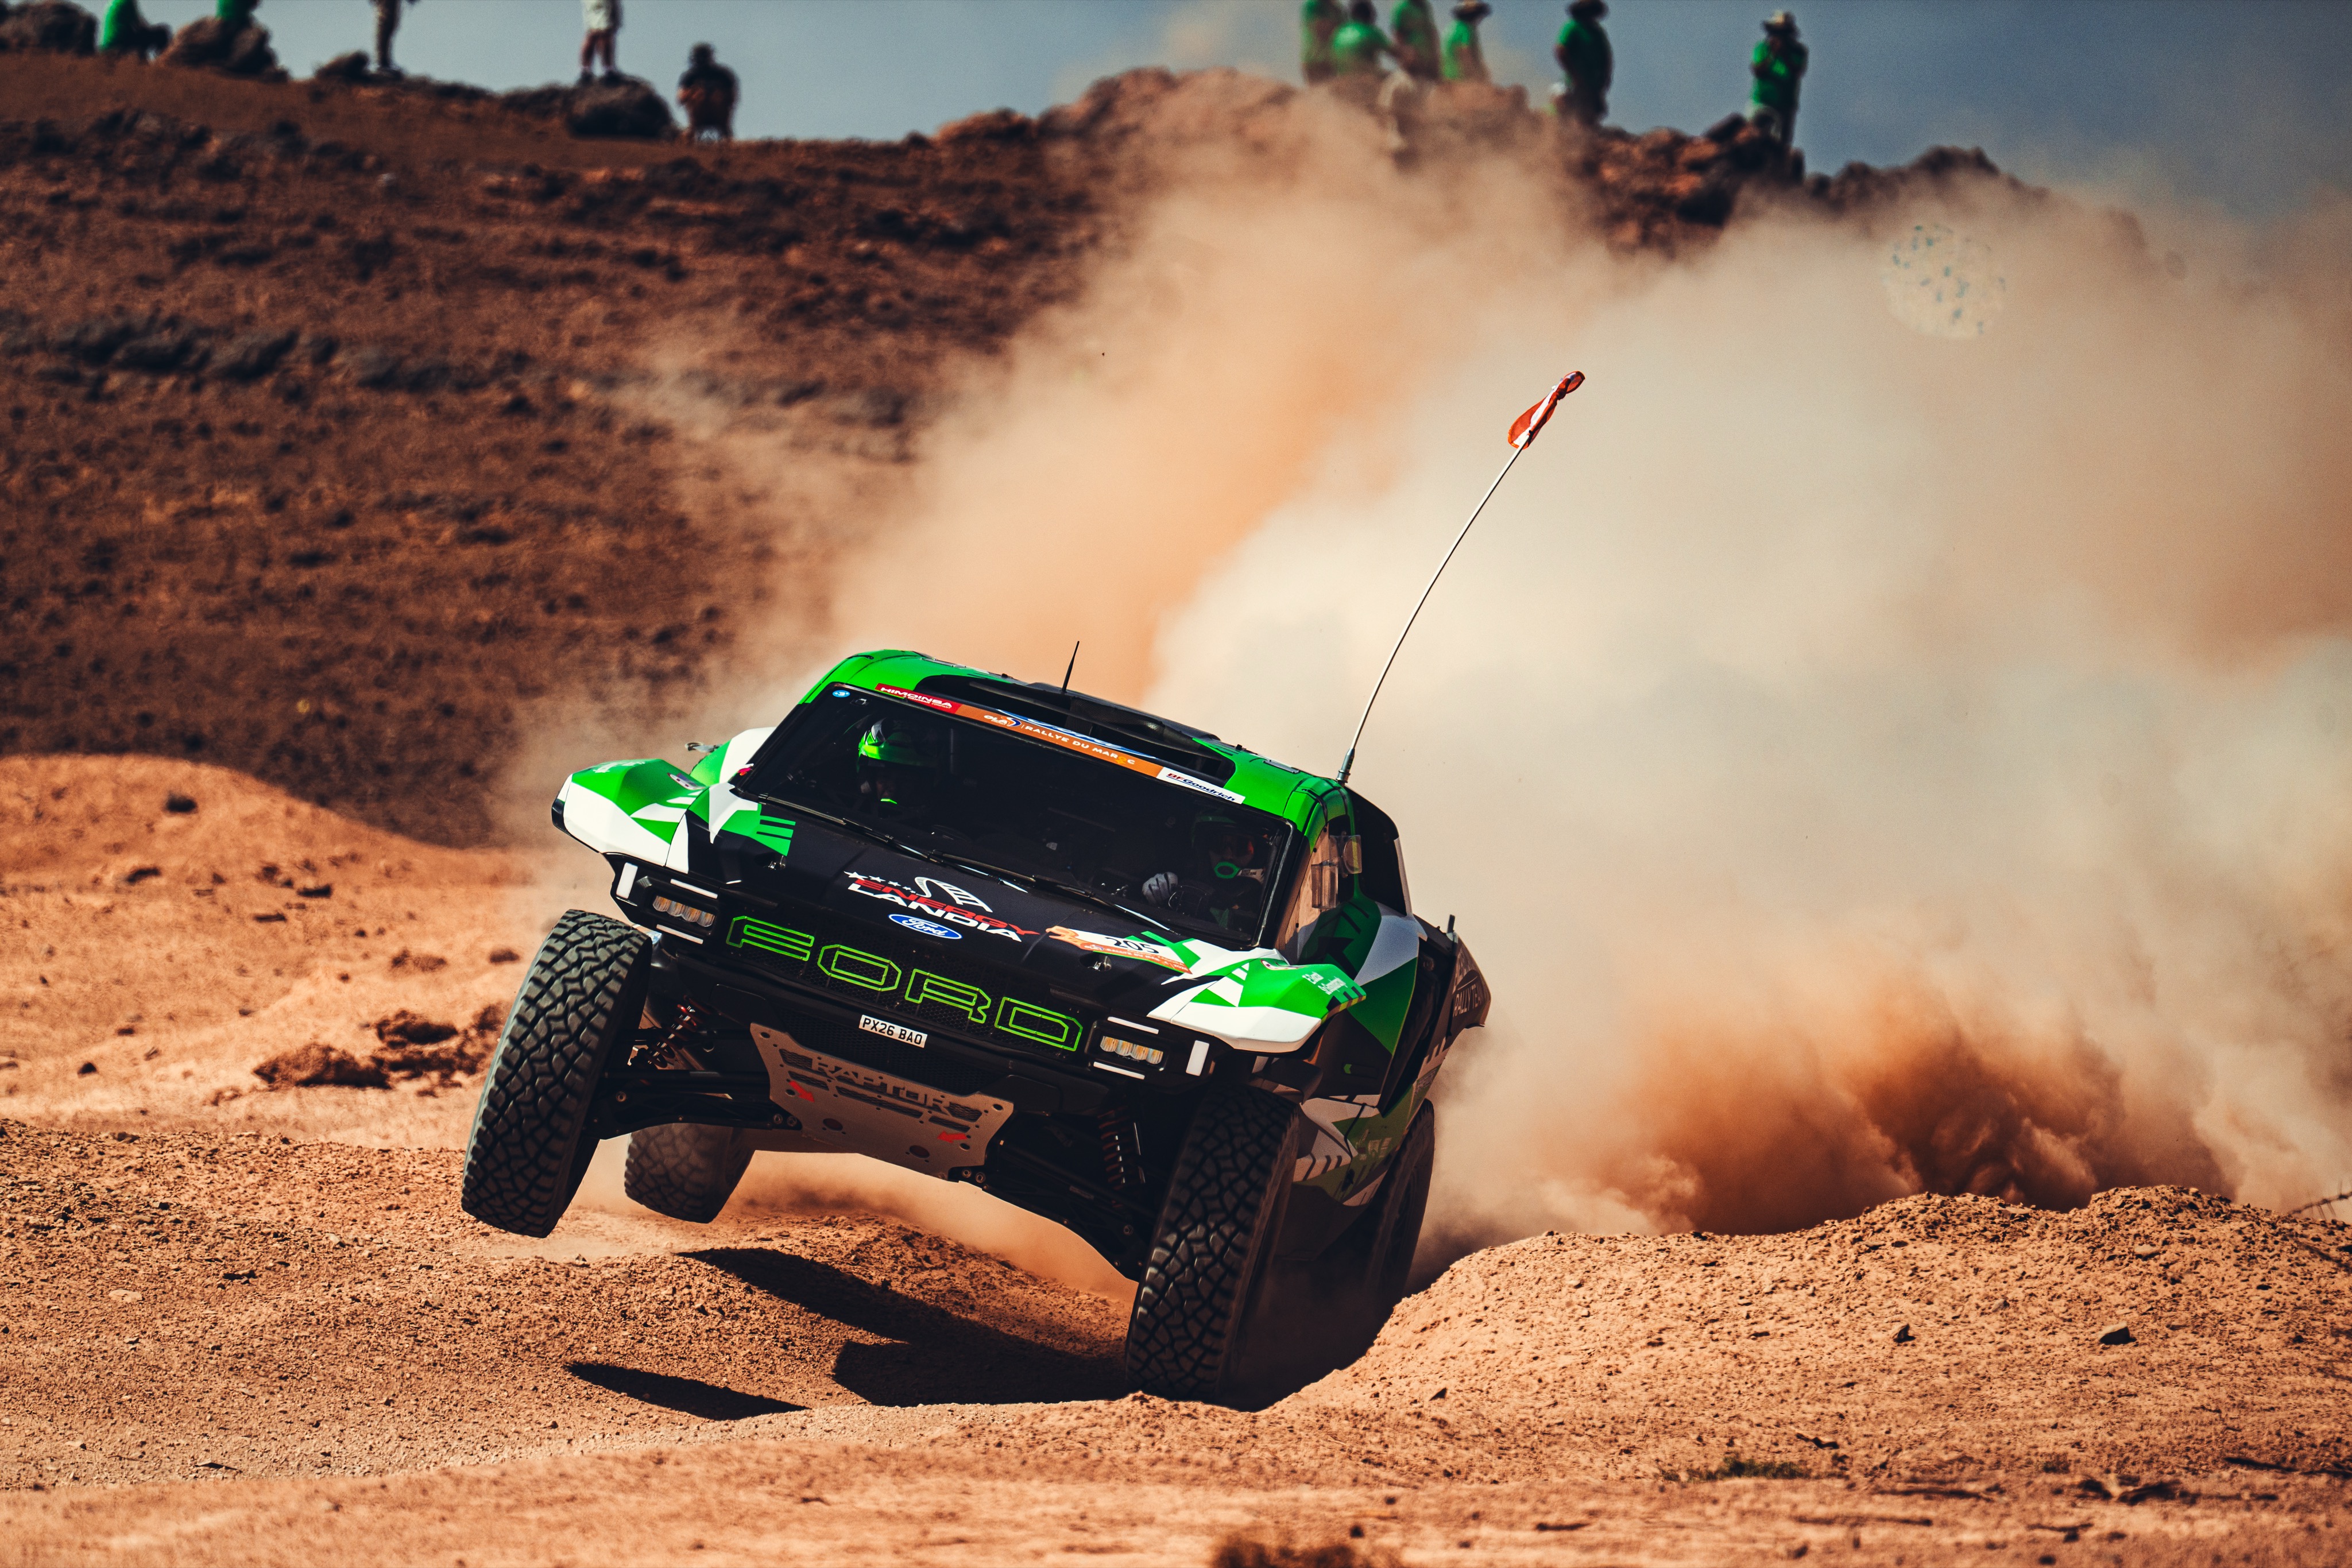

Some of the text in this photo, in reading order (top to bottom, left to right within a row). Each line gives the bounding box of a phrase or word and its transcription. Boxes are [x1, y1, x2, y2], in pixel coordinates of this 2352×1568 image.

[880, 687, 952, 707] HIMOINSA
[1025, 725, 1069, 742] RALLYE
[1073, 740, 1089, 749] DU
[1167, 773, 1235, 801] BFGoodrich
[848, 883, 1022, 942] LANDIA
[854, 878, 1040, 935] ENERGY
[902, 918, 949, 936] Ford
[1105, 937, 1159, 954] 205
[726, 916, 1083, 1051] FORD
[862, 1017, 895, 1036] PX26
[812, 1058, 954, 1117] RAPTOR
